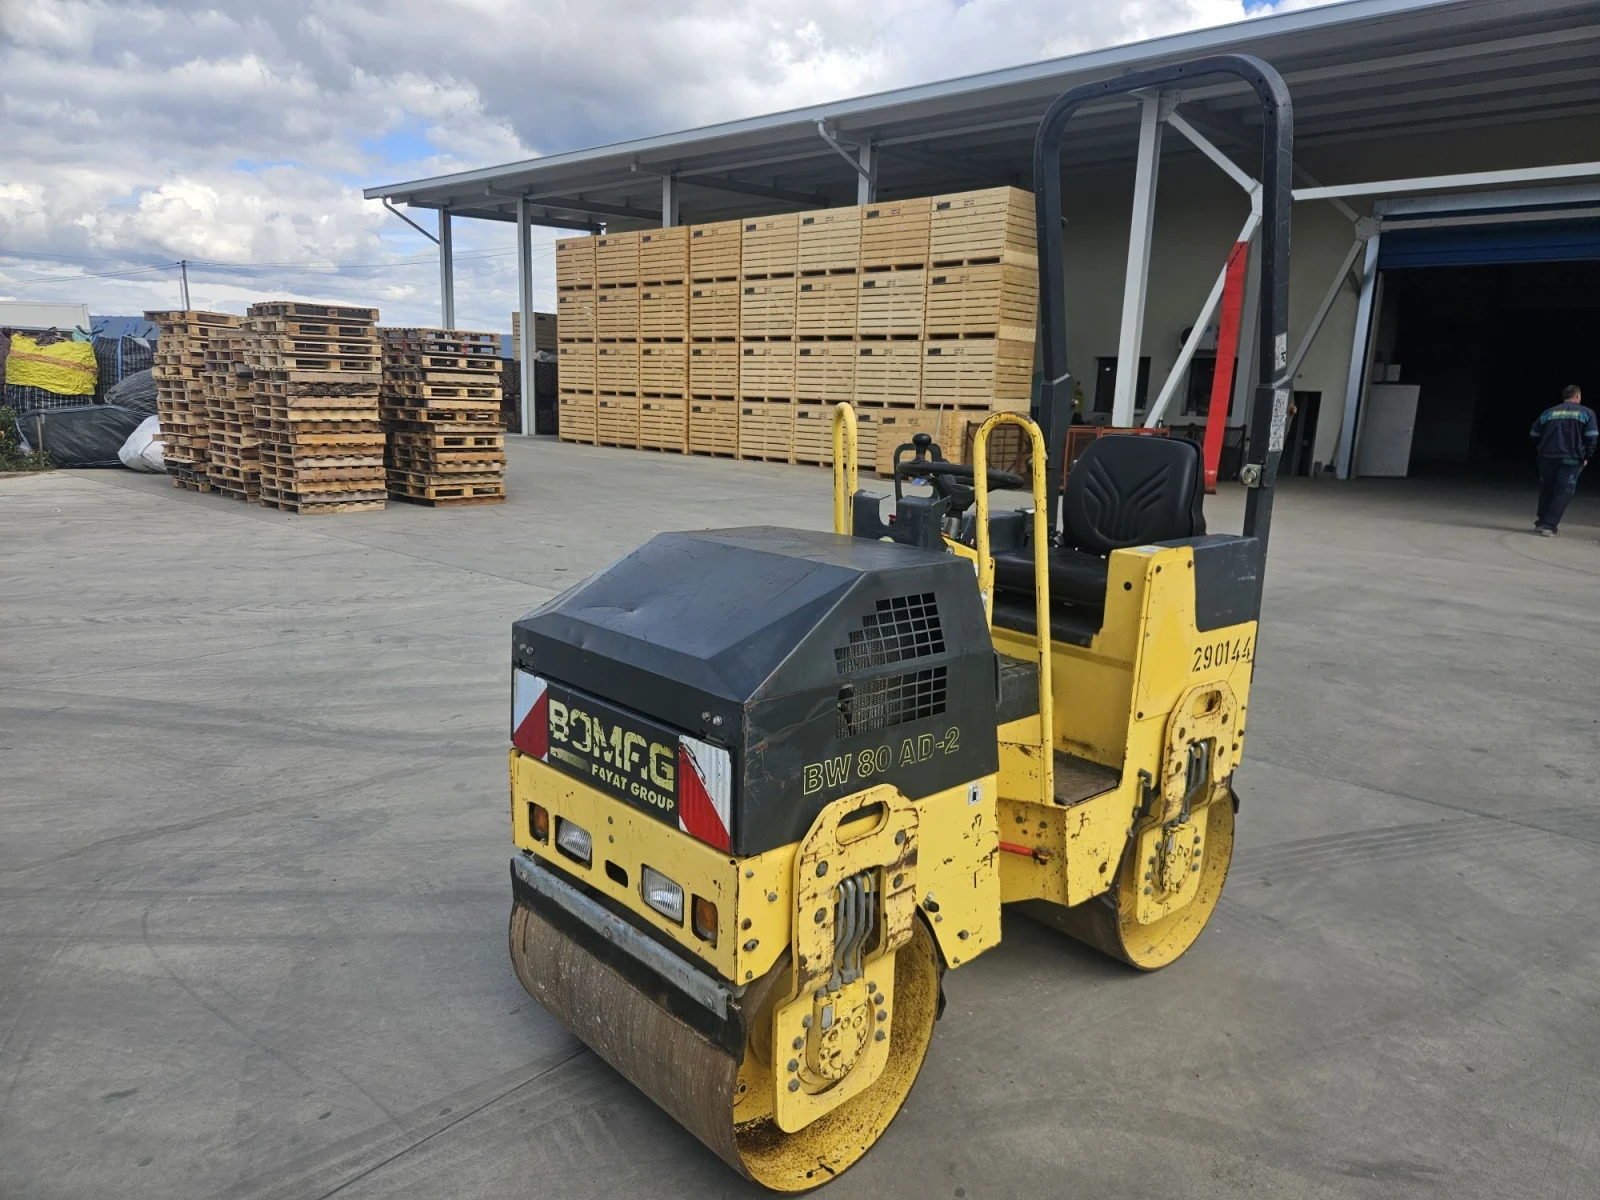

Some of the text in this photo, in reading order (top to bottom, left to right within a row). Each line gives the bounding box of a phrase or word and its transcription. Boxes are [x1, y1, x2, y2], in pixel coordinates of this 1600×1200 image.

[1192, 636, 1251, 672] 290144
[803, 726, 961, 796] BW 80 AD-2
[591, 763, 675, 812] FAYAT GROUP
